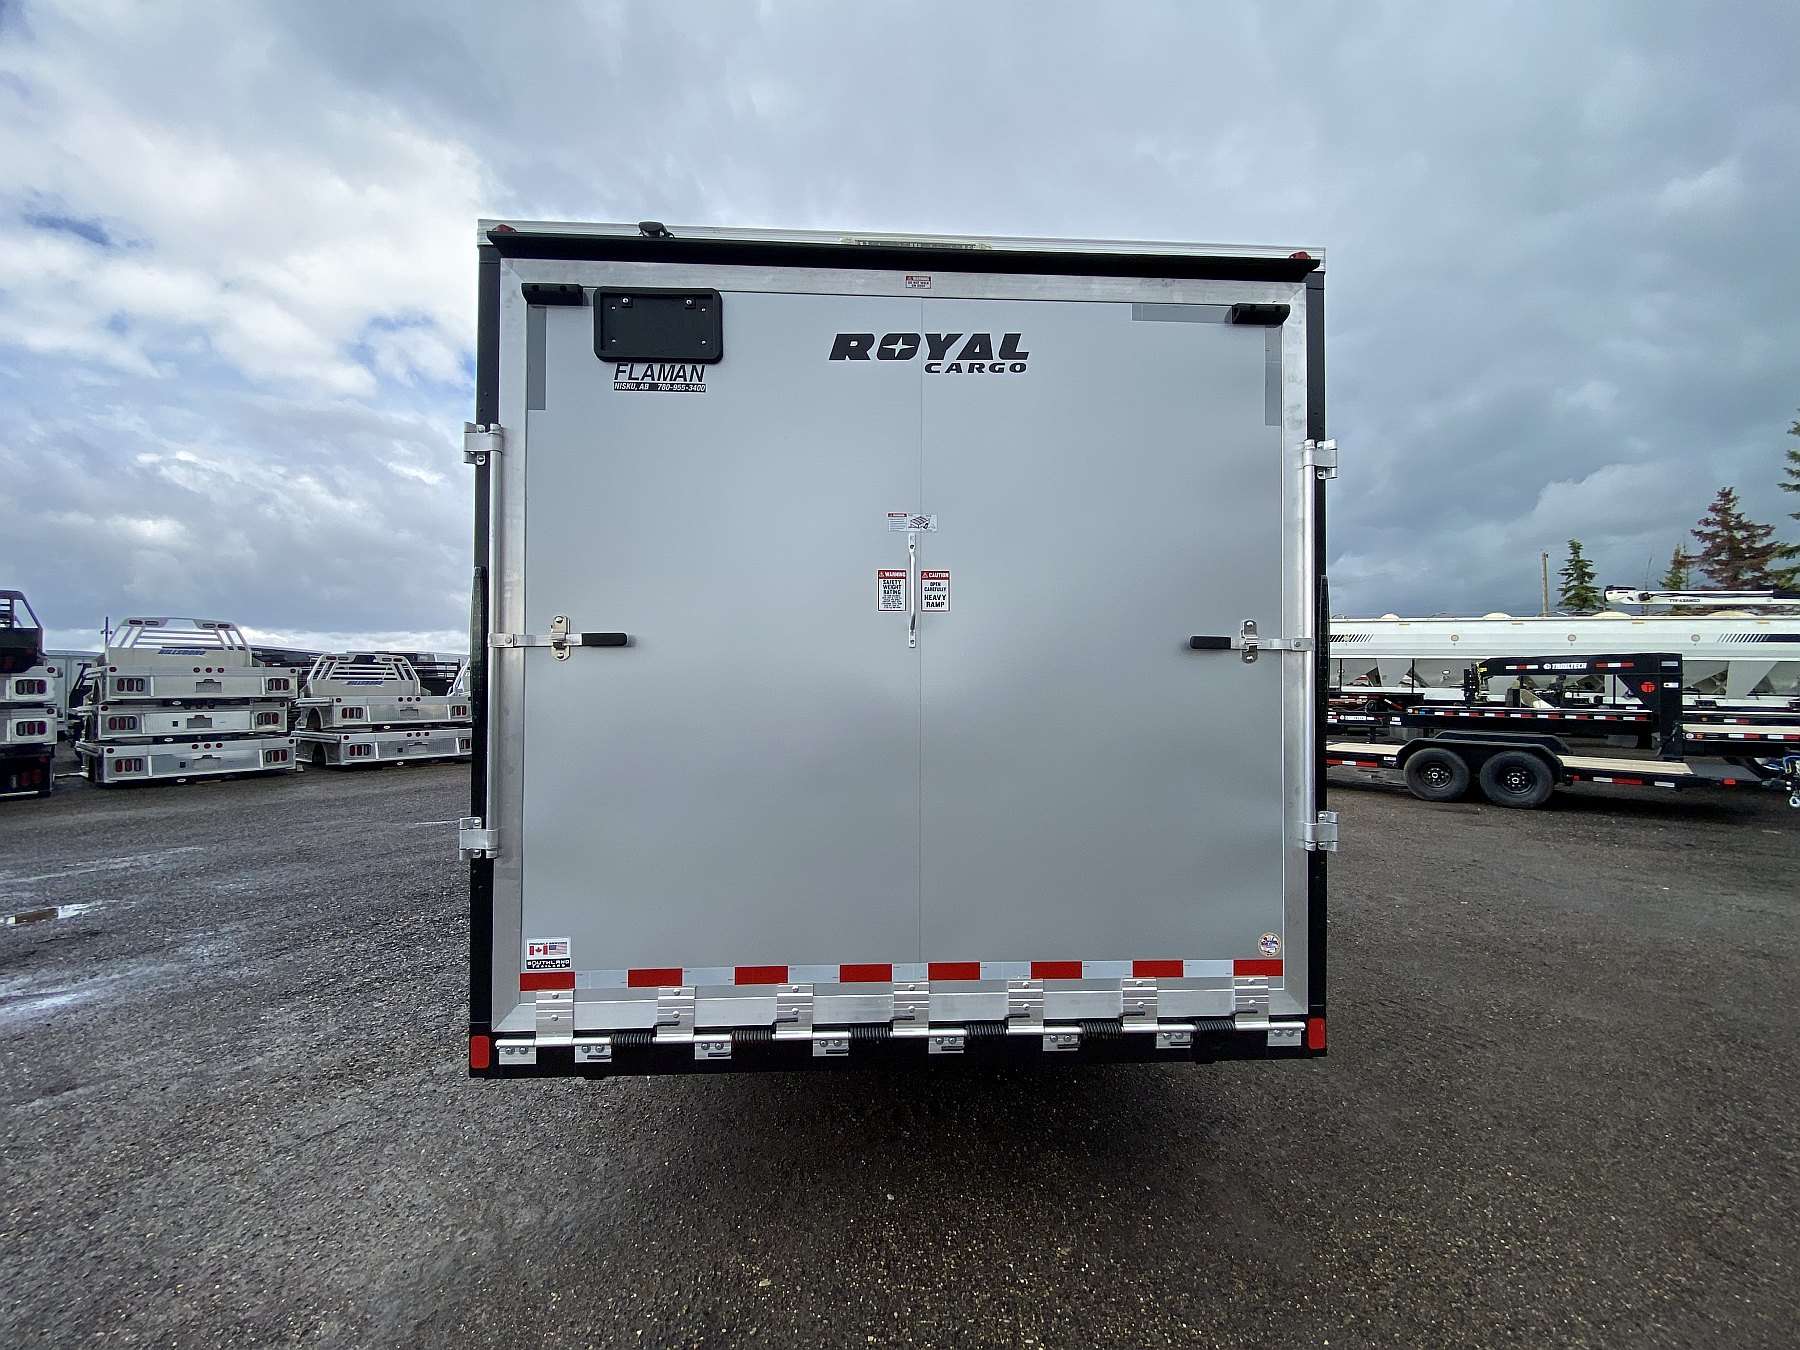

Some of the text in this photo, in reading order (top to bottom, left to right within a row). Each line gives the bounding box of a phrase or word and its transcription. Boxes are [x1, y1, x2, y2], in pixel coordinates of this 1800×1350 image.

[828, 333, 1030, 361] ROYAL
[614, 363, 705, 382] FLAMAN
[924, 362, 1027, 374] CARGO
[657, 383, 705, 391] 780-955-3400
